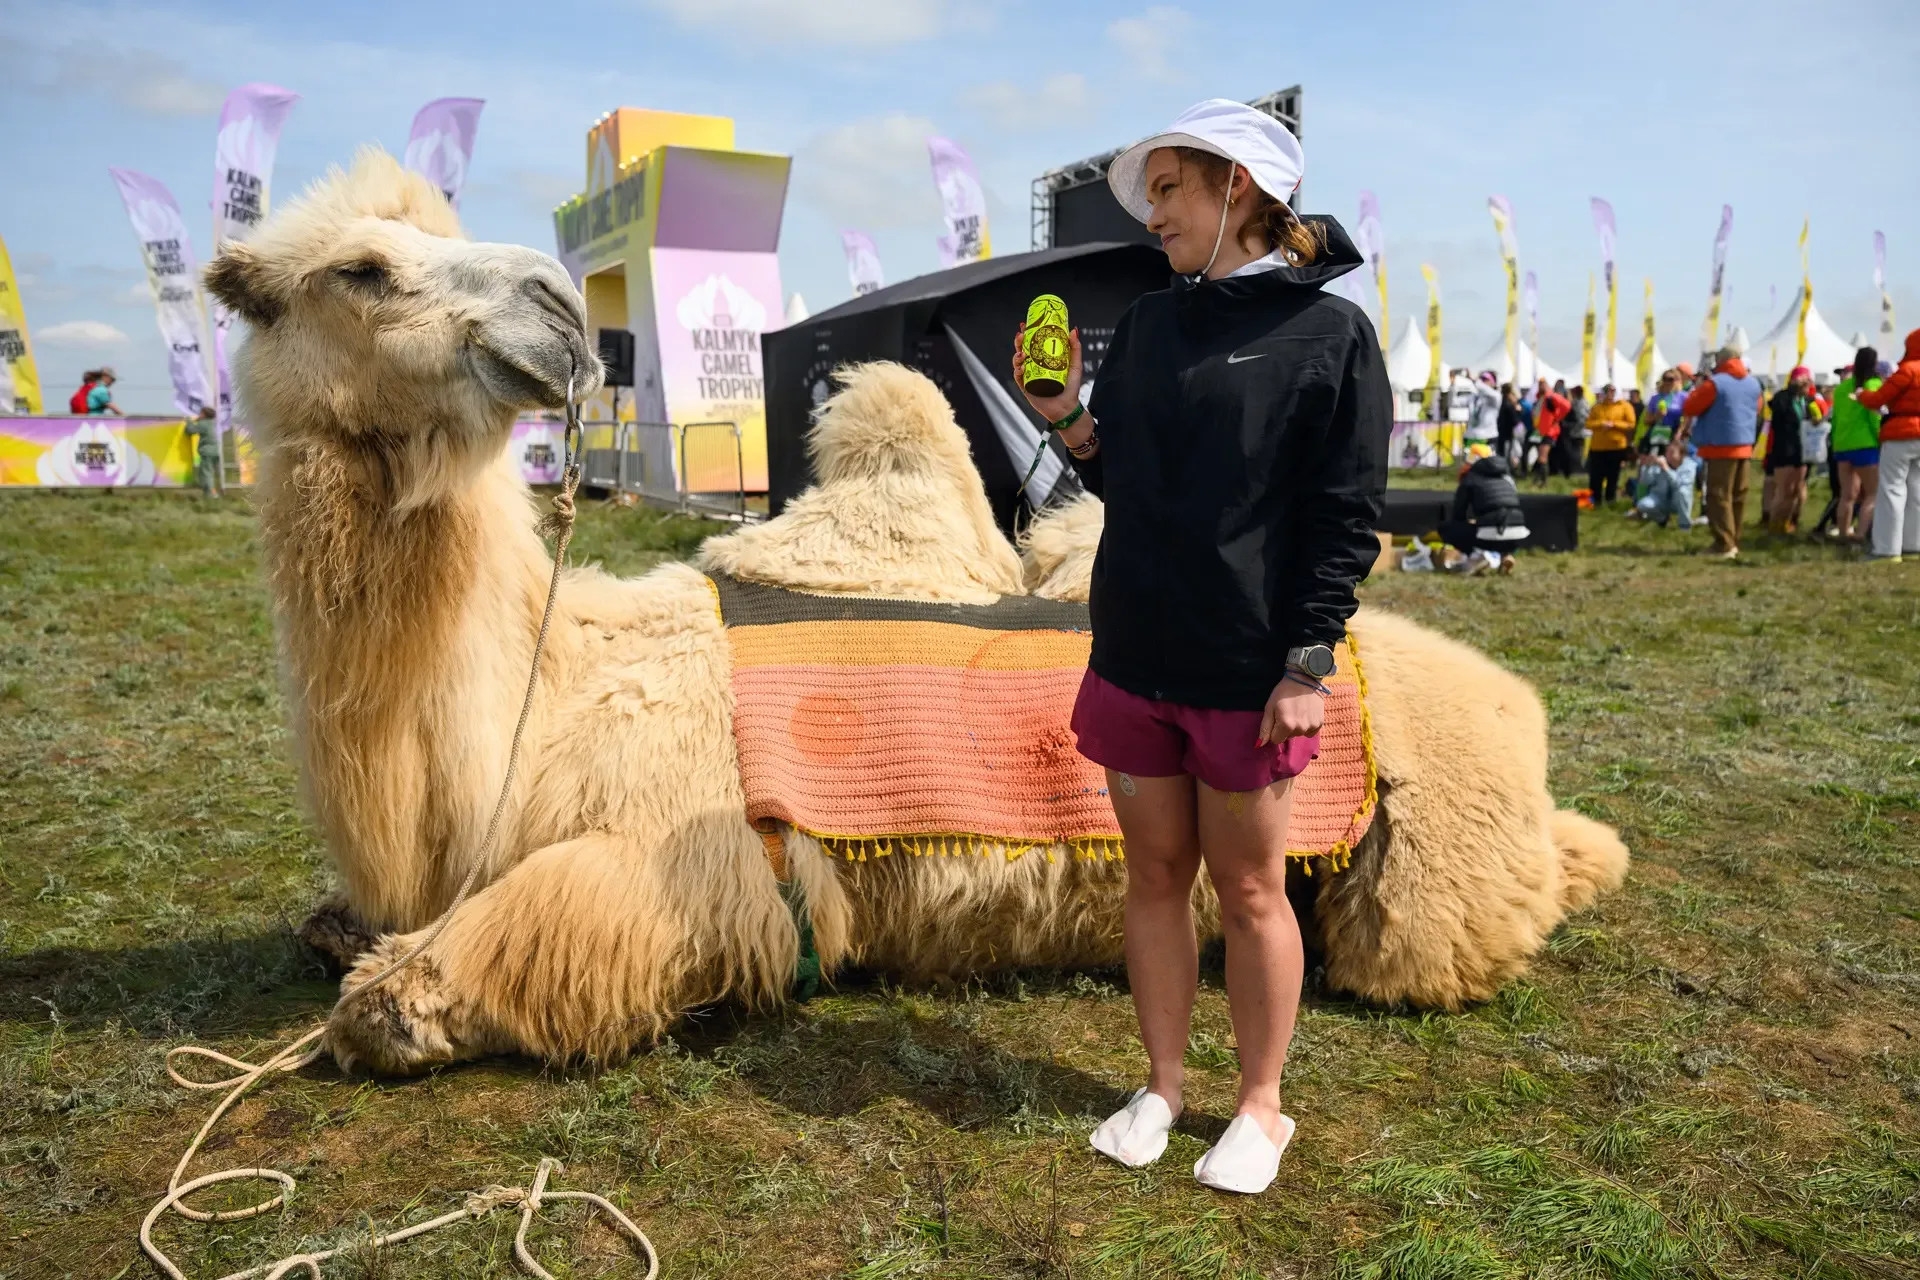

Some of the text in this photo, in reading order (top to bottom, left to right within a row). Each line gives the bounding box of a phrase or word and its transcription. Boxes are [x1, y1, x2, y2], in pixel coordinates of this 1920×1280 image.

[692, 329, 758, 352] KALMYK
[1051, 339, 1057, 355] 1
[701, 353, 754, 375] CAMEL
[697, 377, 763, 399] TROPHY
